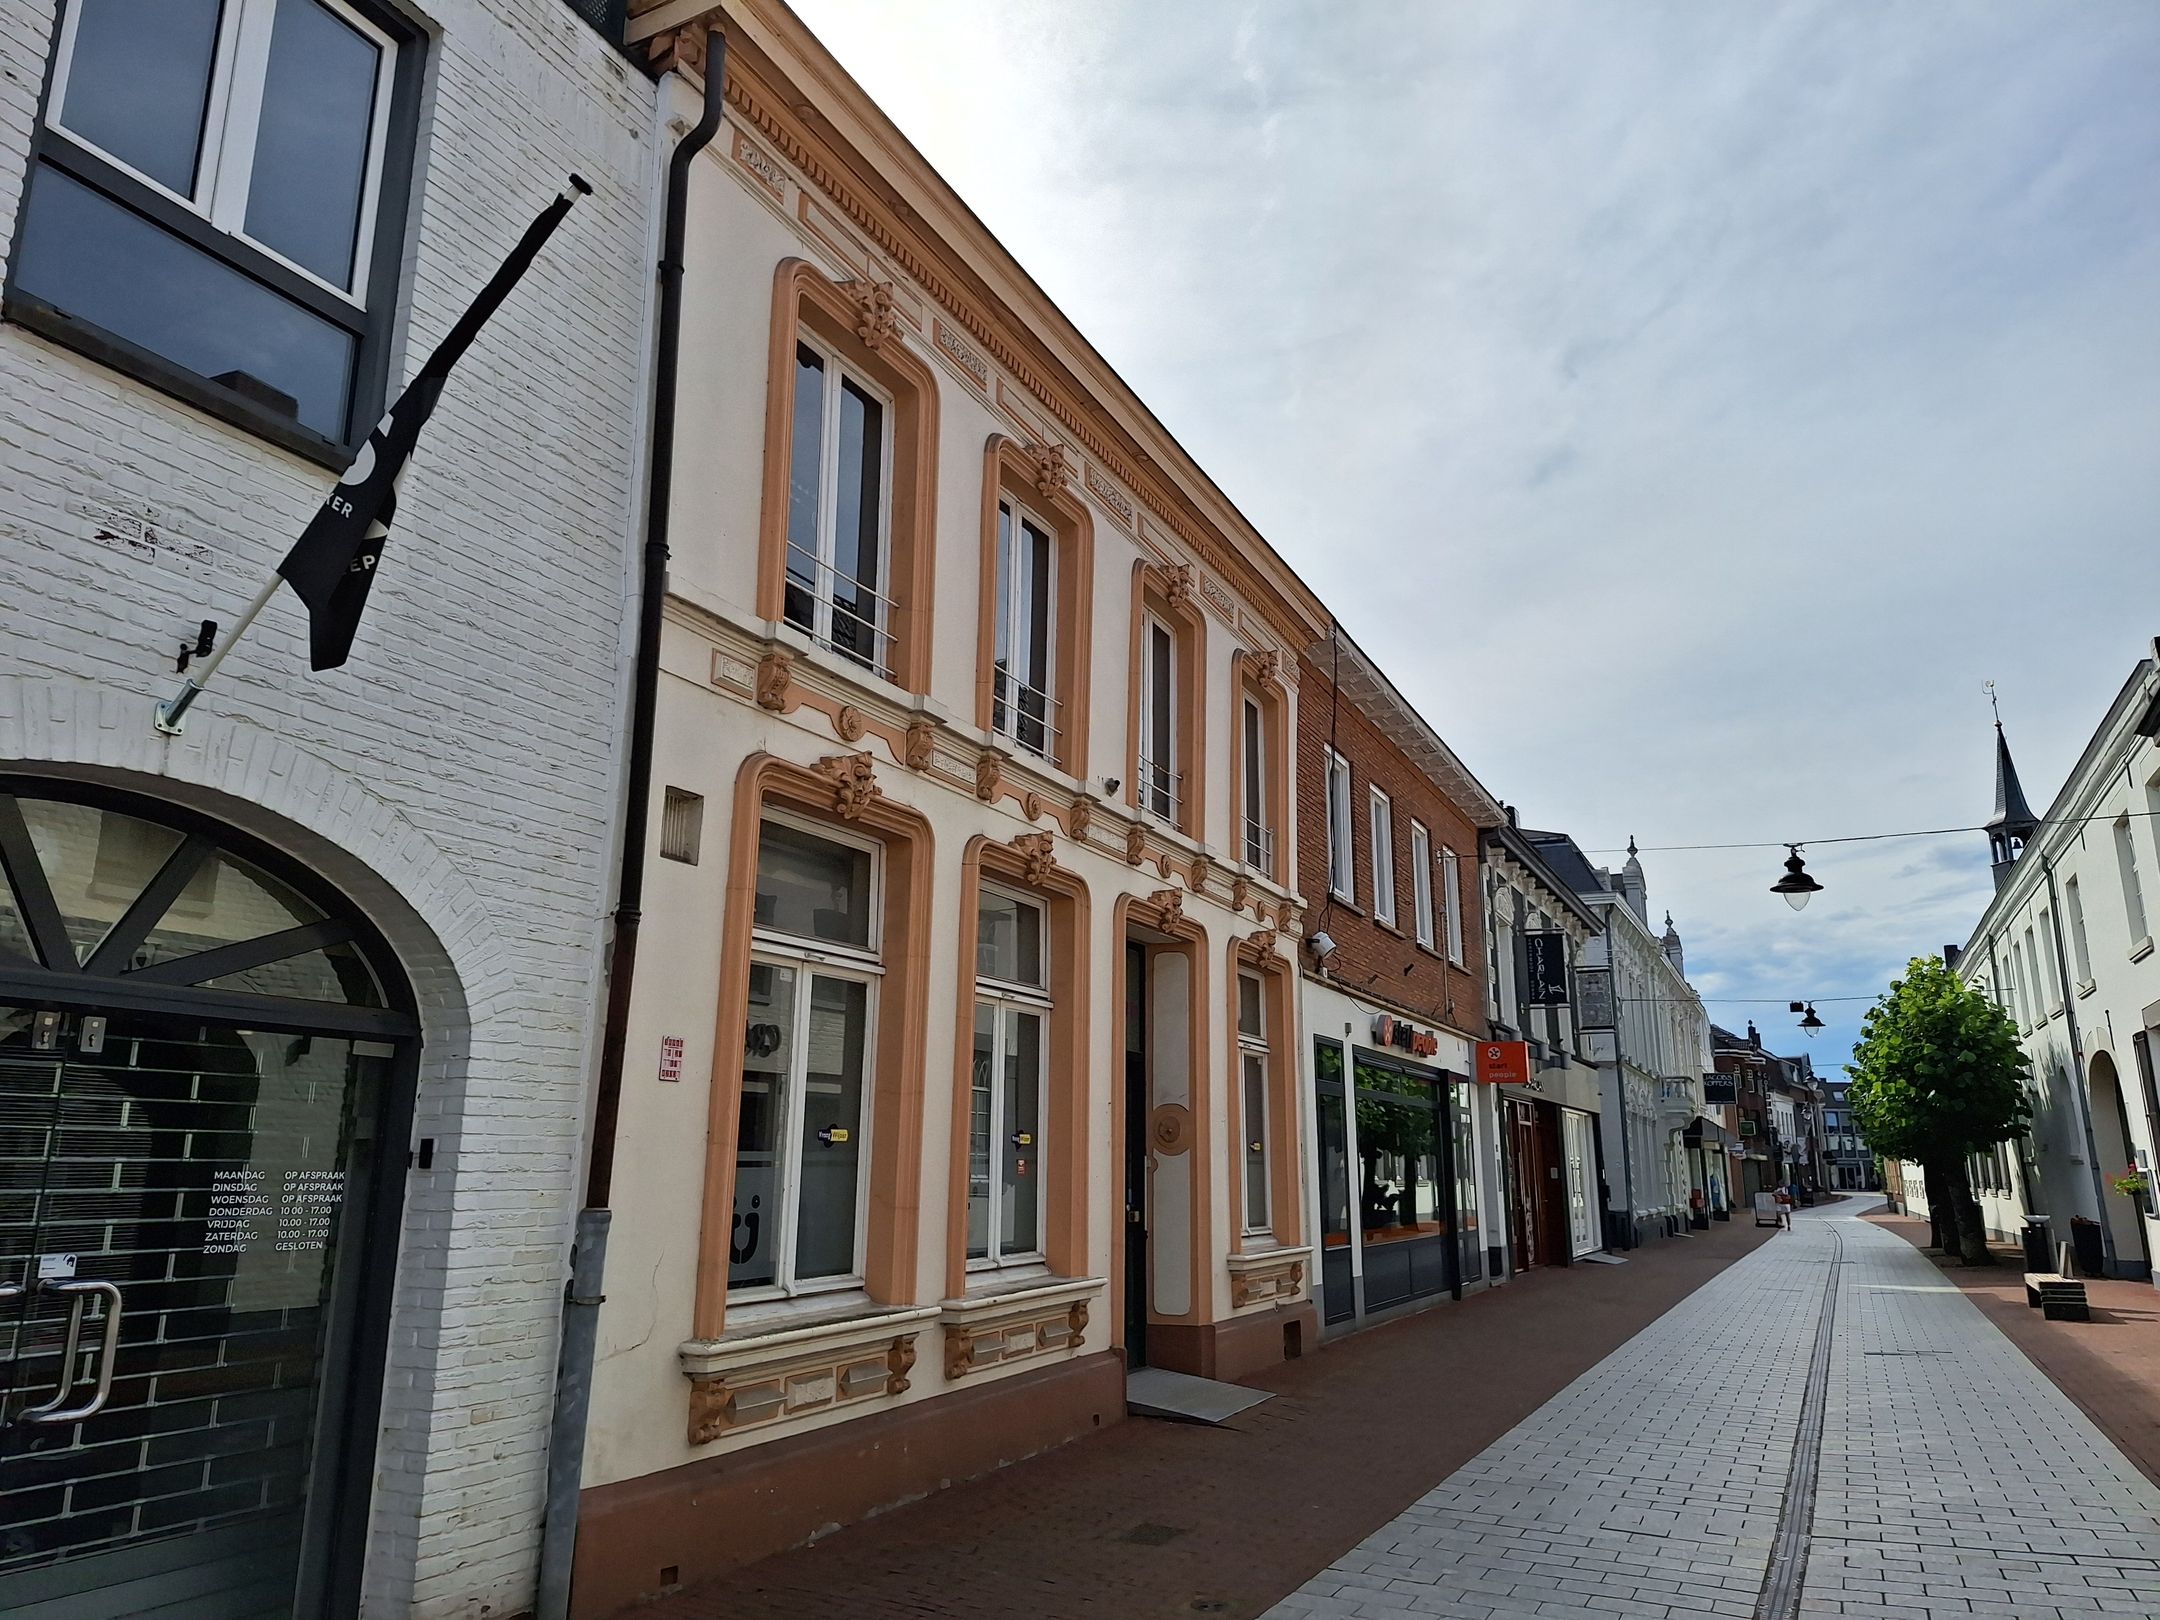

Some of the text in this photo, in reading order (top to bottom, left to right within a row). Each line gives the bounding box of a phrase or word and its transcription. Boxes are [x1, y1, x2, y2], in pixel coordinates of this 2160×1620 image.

[1489, 1071, 1517, 1079] people
[214, 1171, 345, 1180] MAANDAG OP AFSPRAAK
[212, 1183, 343, 1192] DINSDAG OP AFSPRAAK
[211, 1194, 342, 1204] WOENSDAG OP AFSPRAAK
[209, 1207, 273, 1216] DONDERDAG
[310, 1206, 332, 1215] 17.00
[207, 1219, 250, 1228] VRIJDAG
[279, 1218, 302, 1227] 10.00
[309, 1218, 331, 1227] 17.00
[205, 1232, 258, 1241] ZATERDAG
[277, 1230, 300, 1239] 10.00
[308, 1229, 329, 1238] 17.00
[203, 1241, 323, 1254] ZONDAG GESLOTEN
